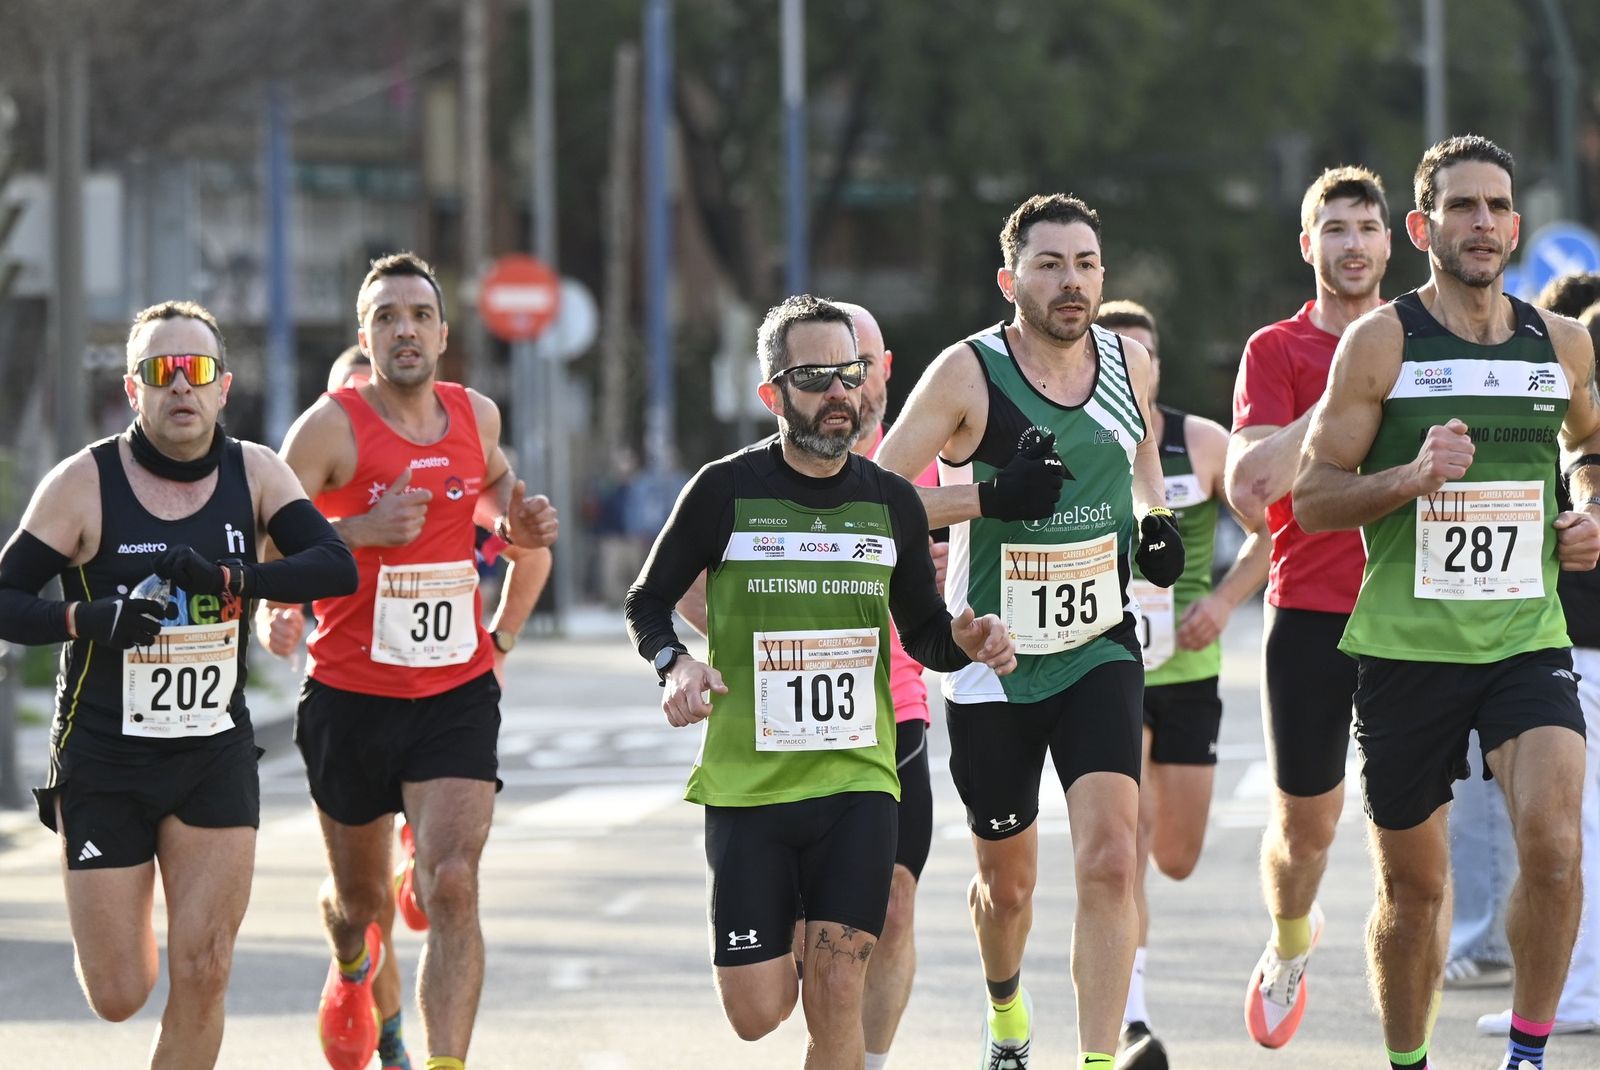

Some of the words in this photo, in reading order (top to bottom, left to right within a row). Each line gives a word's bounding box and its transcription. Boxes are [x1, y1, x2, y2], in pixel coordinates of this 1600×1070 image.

[1415, 377, 1453, 386] CÓRDOBA
[1494, 425, 1555, 443] CORDOBÉS
[1044, 459, 1062, 468] FILA
[1424, 491, 1466, 522] XLII
[1503, 490, 1525, 499] POPULAR
[753, 544, 785, 552] CÓRDOBA
[1149, 541, 1166, 552] FILA
[1445, 526, 1518, 573] 287
[1009, 552, 1049, 581] XLII
[747, 578, 817, 594] ATLETISMO
[822, 579, 885, 596] CORDOBÉS
[1032, 579, 1098, 628] 135
[411, 601, 452, 642] 30
[761, 640, 806, 671] XLII
[151, 665, 221, 711] 202
[787, 672, 855, 723] 103
